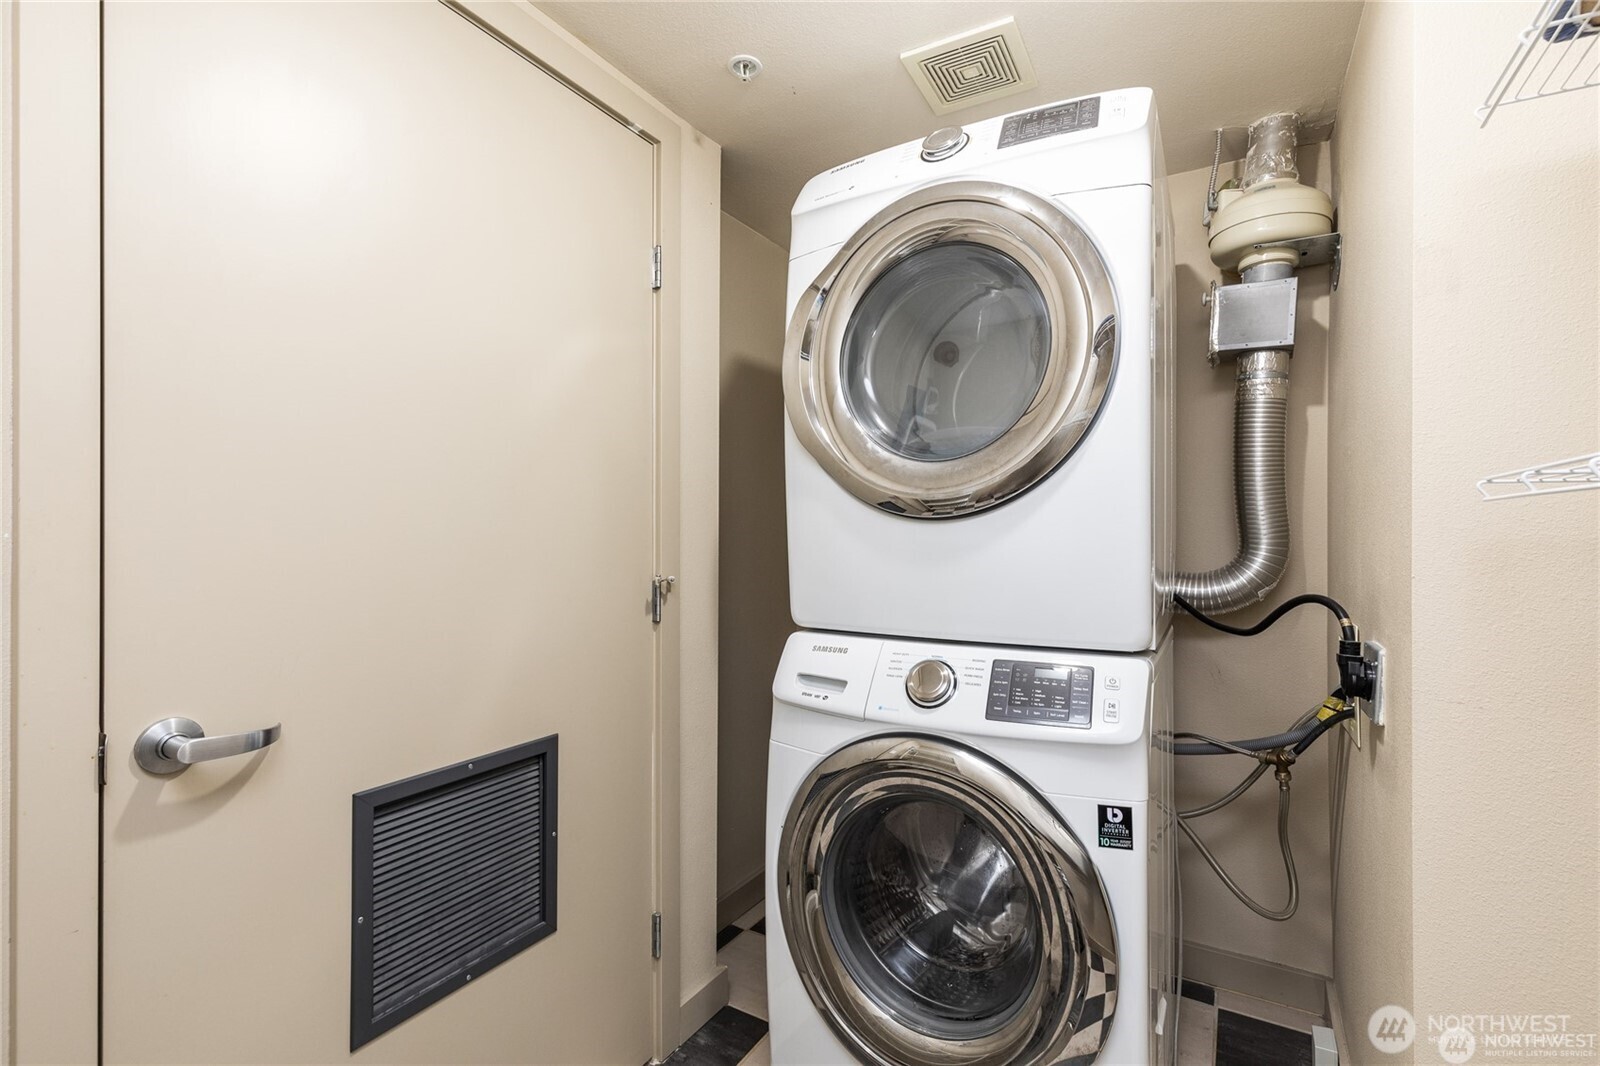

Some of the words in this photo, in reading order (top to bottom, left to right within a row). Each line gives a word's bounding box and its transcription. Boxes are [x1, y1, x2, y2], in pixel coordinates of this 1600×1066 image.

[812, 645, 849, 655] SAMSUNG
[1104, 822, 1126, 830] DIGITAL
[1101, 827, 1130, 835] INVERTER
[1100, 837, 1110, 847] 10
